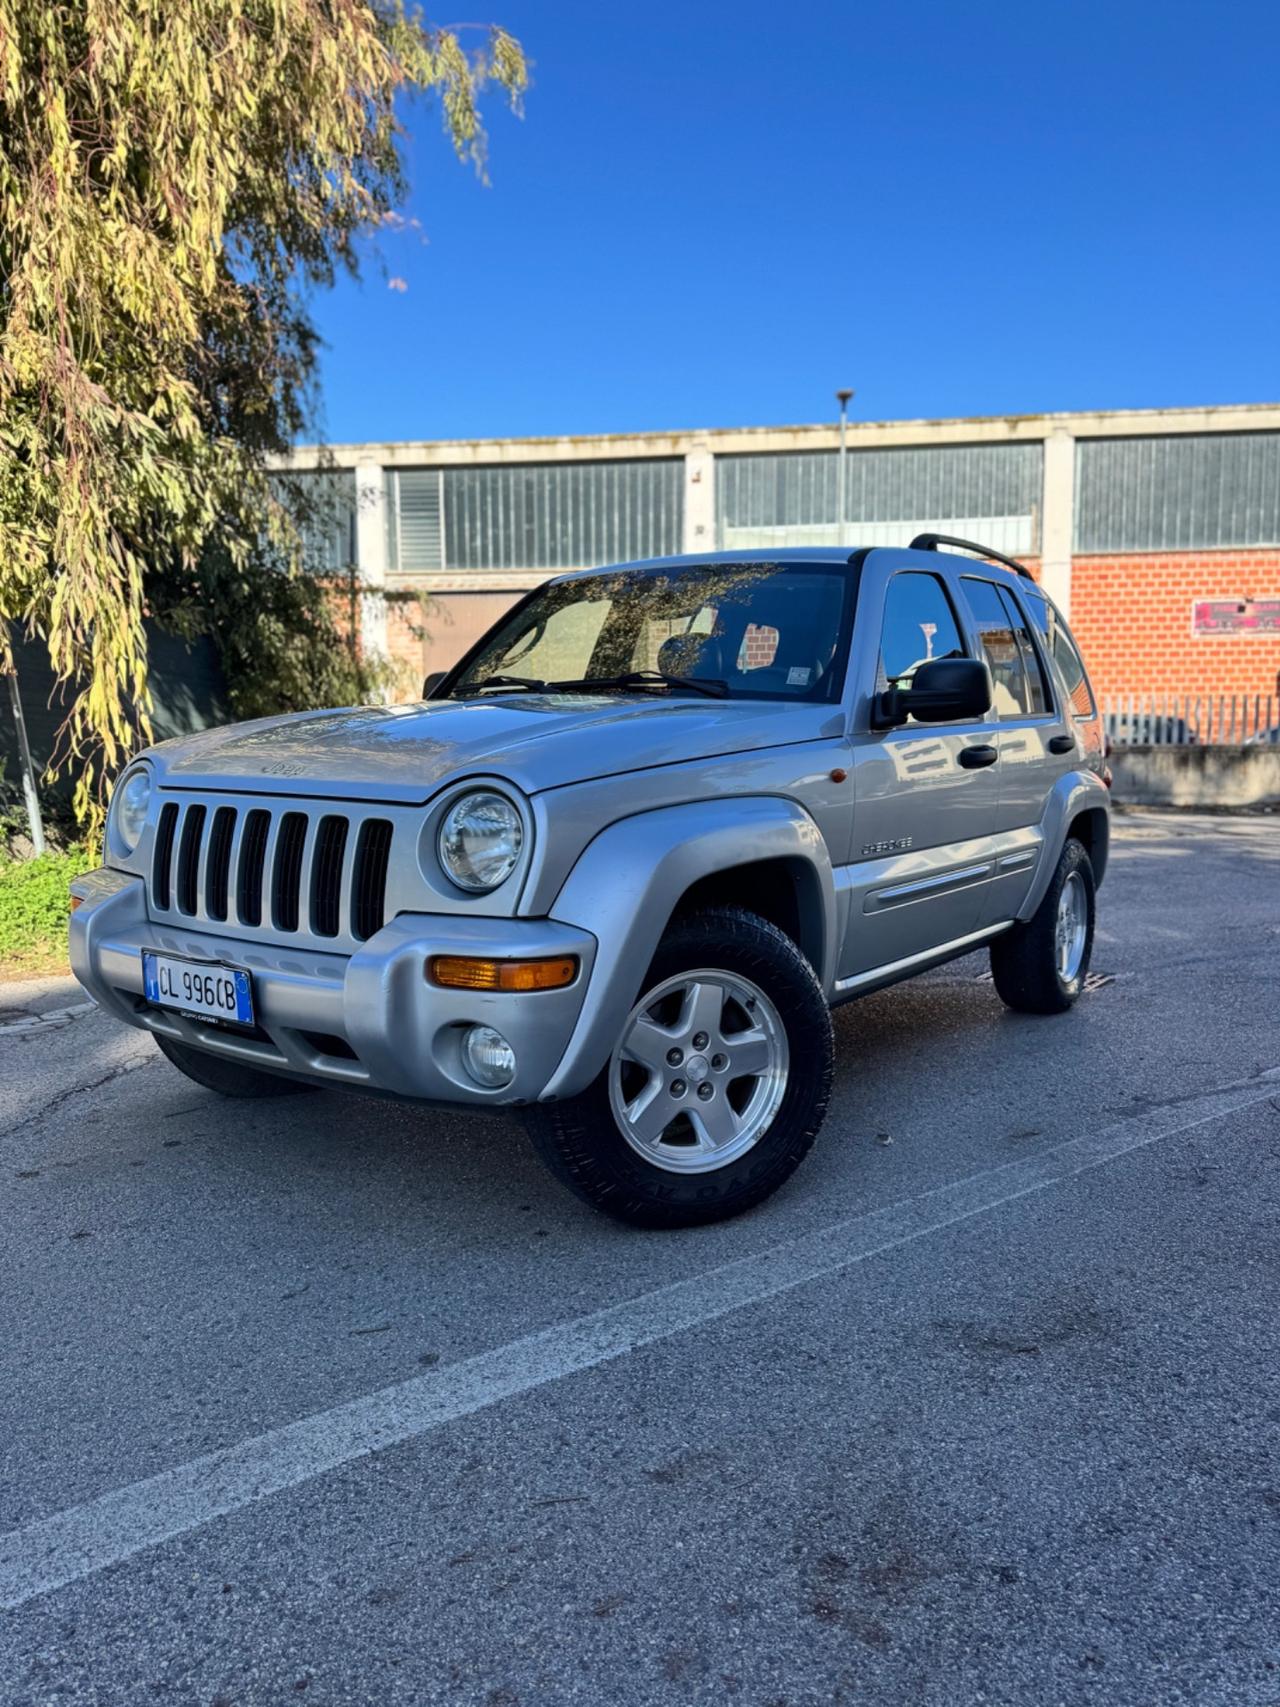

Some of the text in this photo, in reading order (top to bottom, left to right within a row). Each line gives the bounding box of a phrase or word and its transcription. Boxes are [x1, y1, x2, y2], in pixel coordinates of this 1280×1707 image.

[261, 760, 305, 777] Jeep
[862, 836, 913, 854] CHEROKEE
[160, 966, 179, 998] CL
[183, 972, 236, 1011] 996CB
